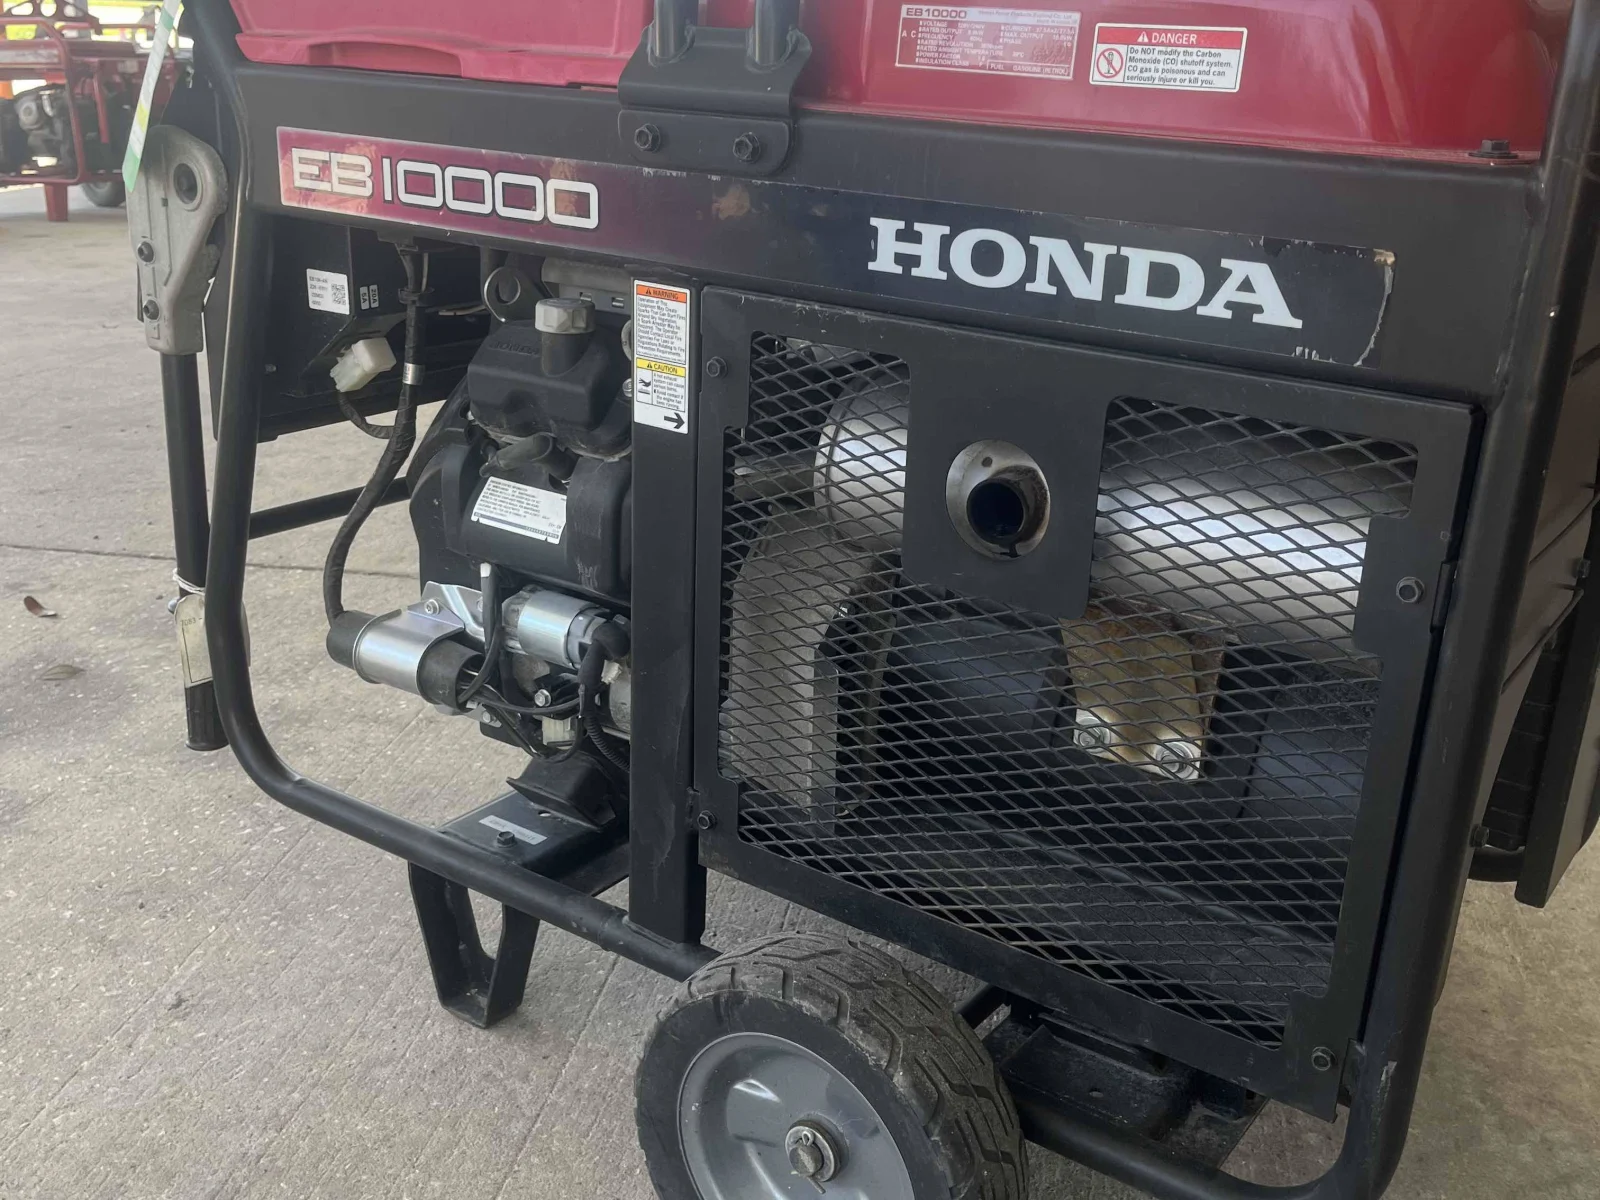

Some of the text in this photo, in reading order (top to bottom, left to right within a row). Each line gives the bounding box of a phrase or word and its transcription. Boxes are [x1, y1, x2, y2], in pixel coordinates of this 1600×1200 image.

[906, 8, 967, 19] EB10000
[939, 40, 974, 48] REVOLUTION
[1152, 32, 1197, 45] DANGER
[1157, 48, 1181, 57] modify
[1195, 50, 1222, 58] Carbon
[990, 62, 1005, 70] FUEL
[1012, 64, 1041, 73] GASOLINE
[1128, 56, 1233, 69] Monoxide (CO) shutoff system.
[1139, 66, 1152, 74] gas
[1153, 66, 1160, 74] is
[1161, 67, 1196, 76] poisonous
[1126, 74, 1156, 83] seriously
[1157, 75, 1177, 84] injure
[1200, 78, 1215, 87] you.
[291, 147, 599, 230] EB10000
[867, 217, 1303, 329] HONDA
[652, 289, 679, 300] WARNING
[654, 363, 678, 374] CAUTION
